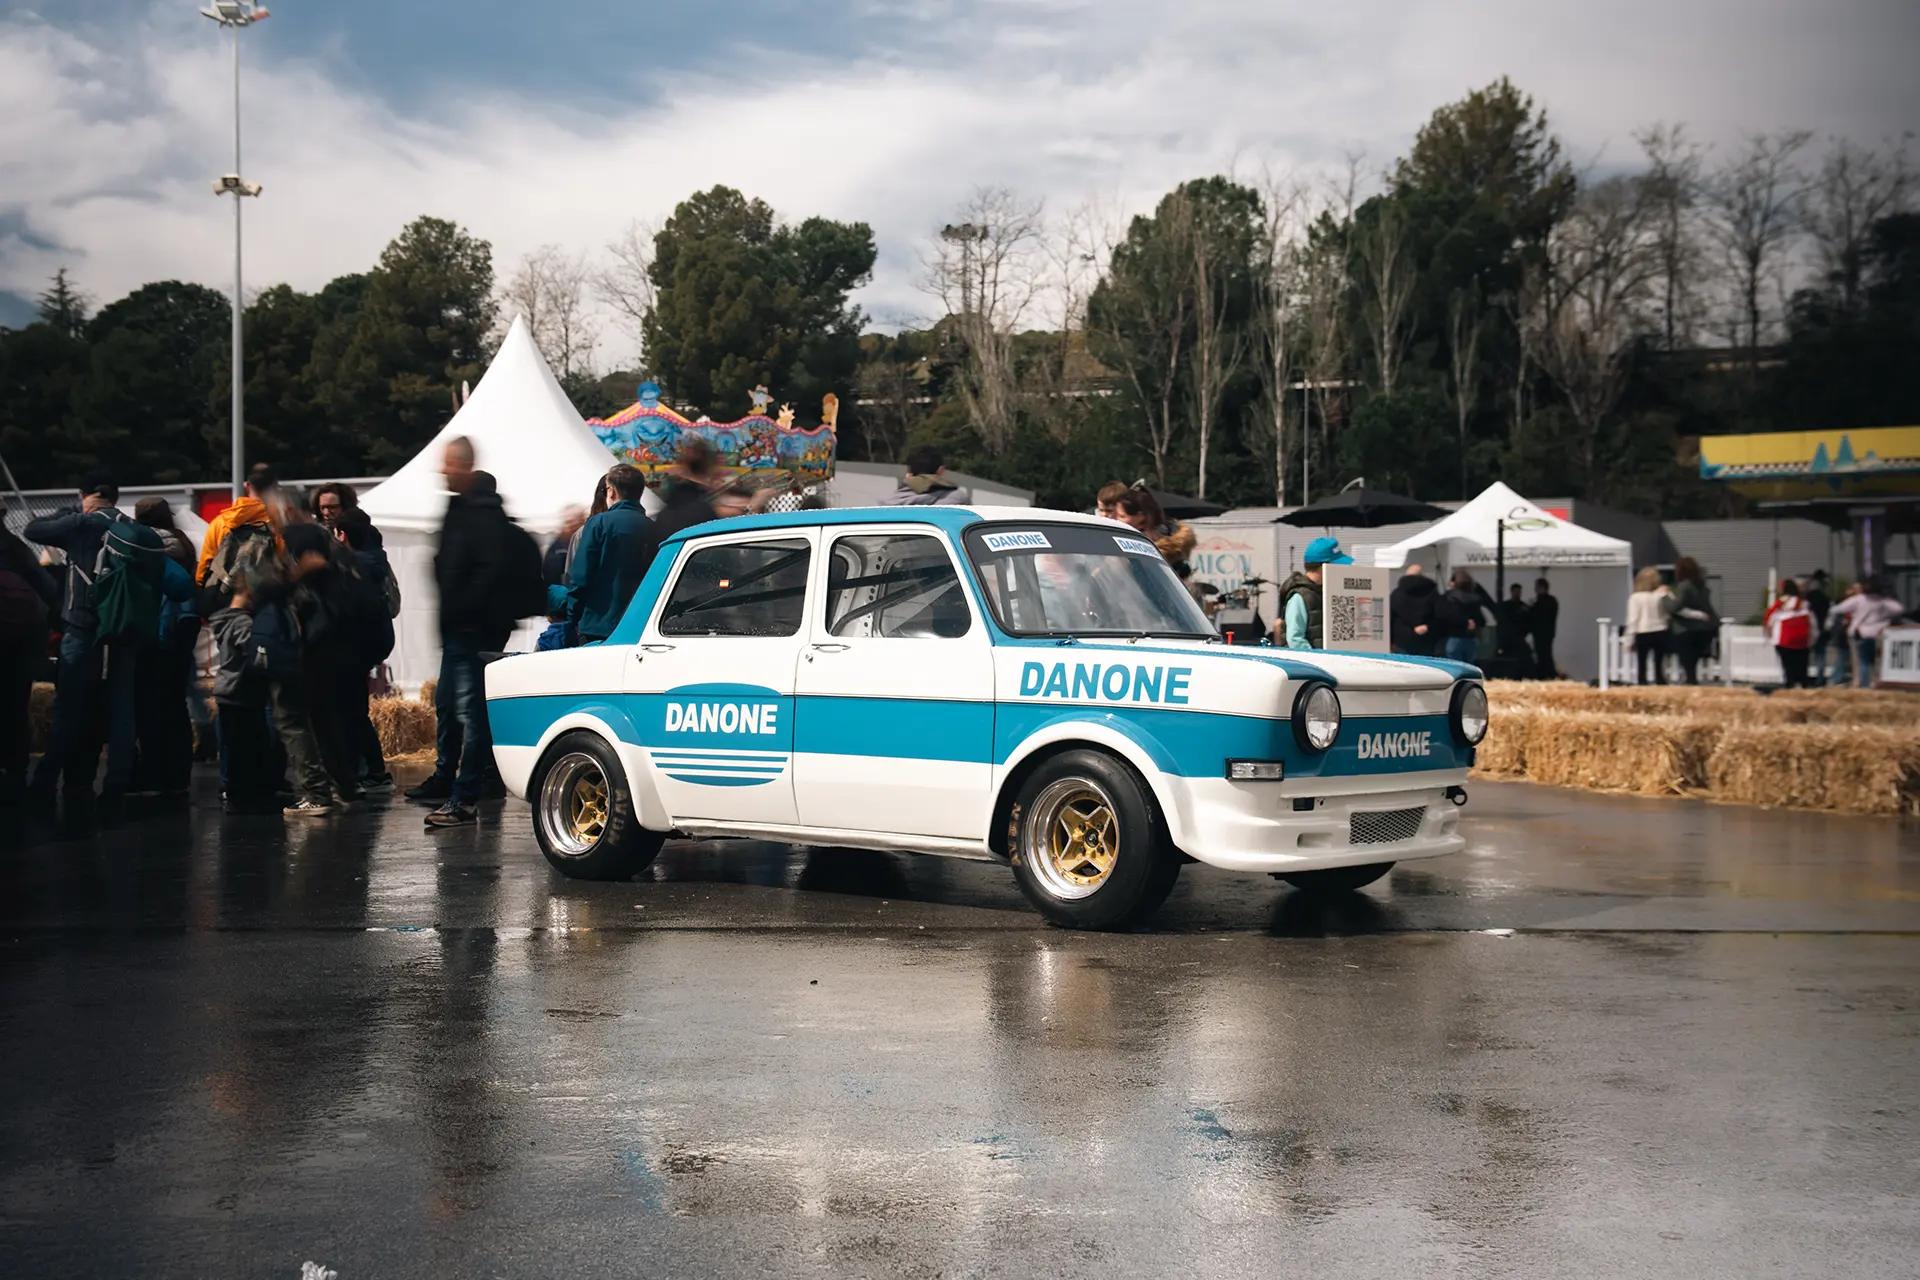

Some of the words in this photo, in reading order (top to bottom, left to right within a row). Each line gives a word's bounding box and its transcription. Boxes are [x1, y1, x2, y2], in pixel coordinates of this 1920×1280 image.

[988, 534, 1047, 548] DANONE
[1019, 661, 1193, 704] DANONE
[665, 702, 779, 735] DANONE
[1357, 731, 1432, 759] DANONE
